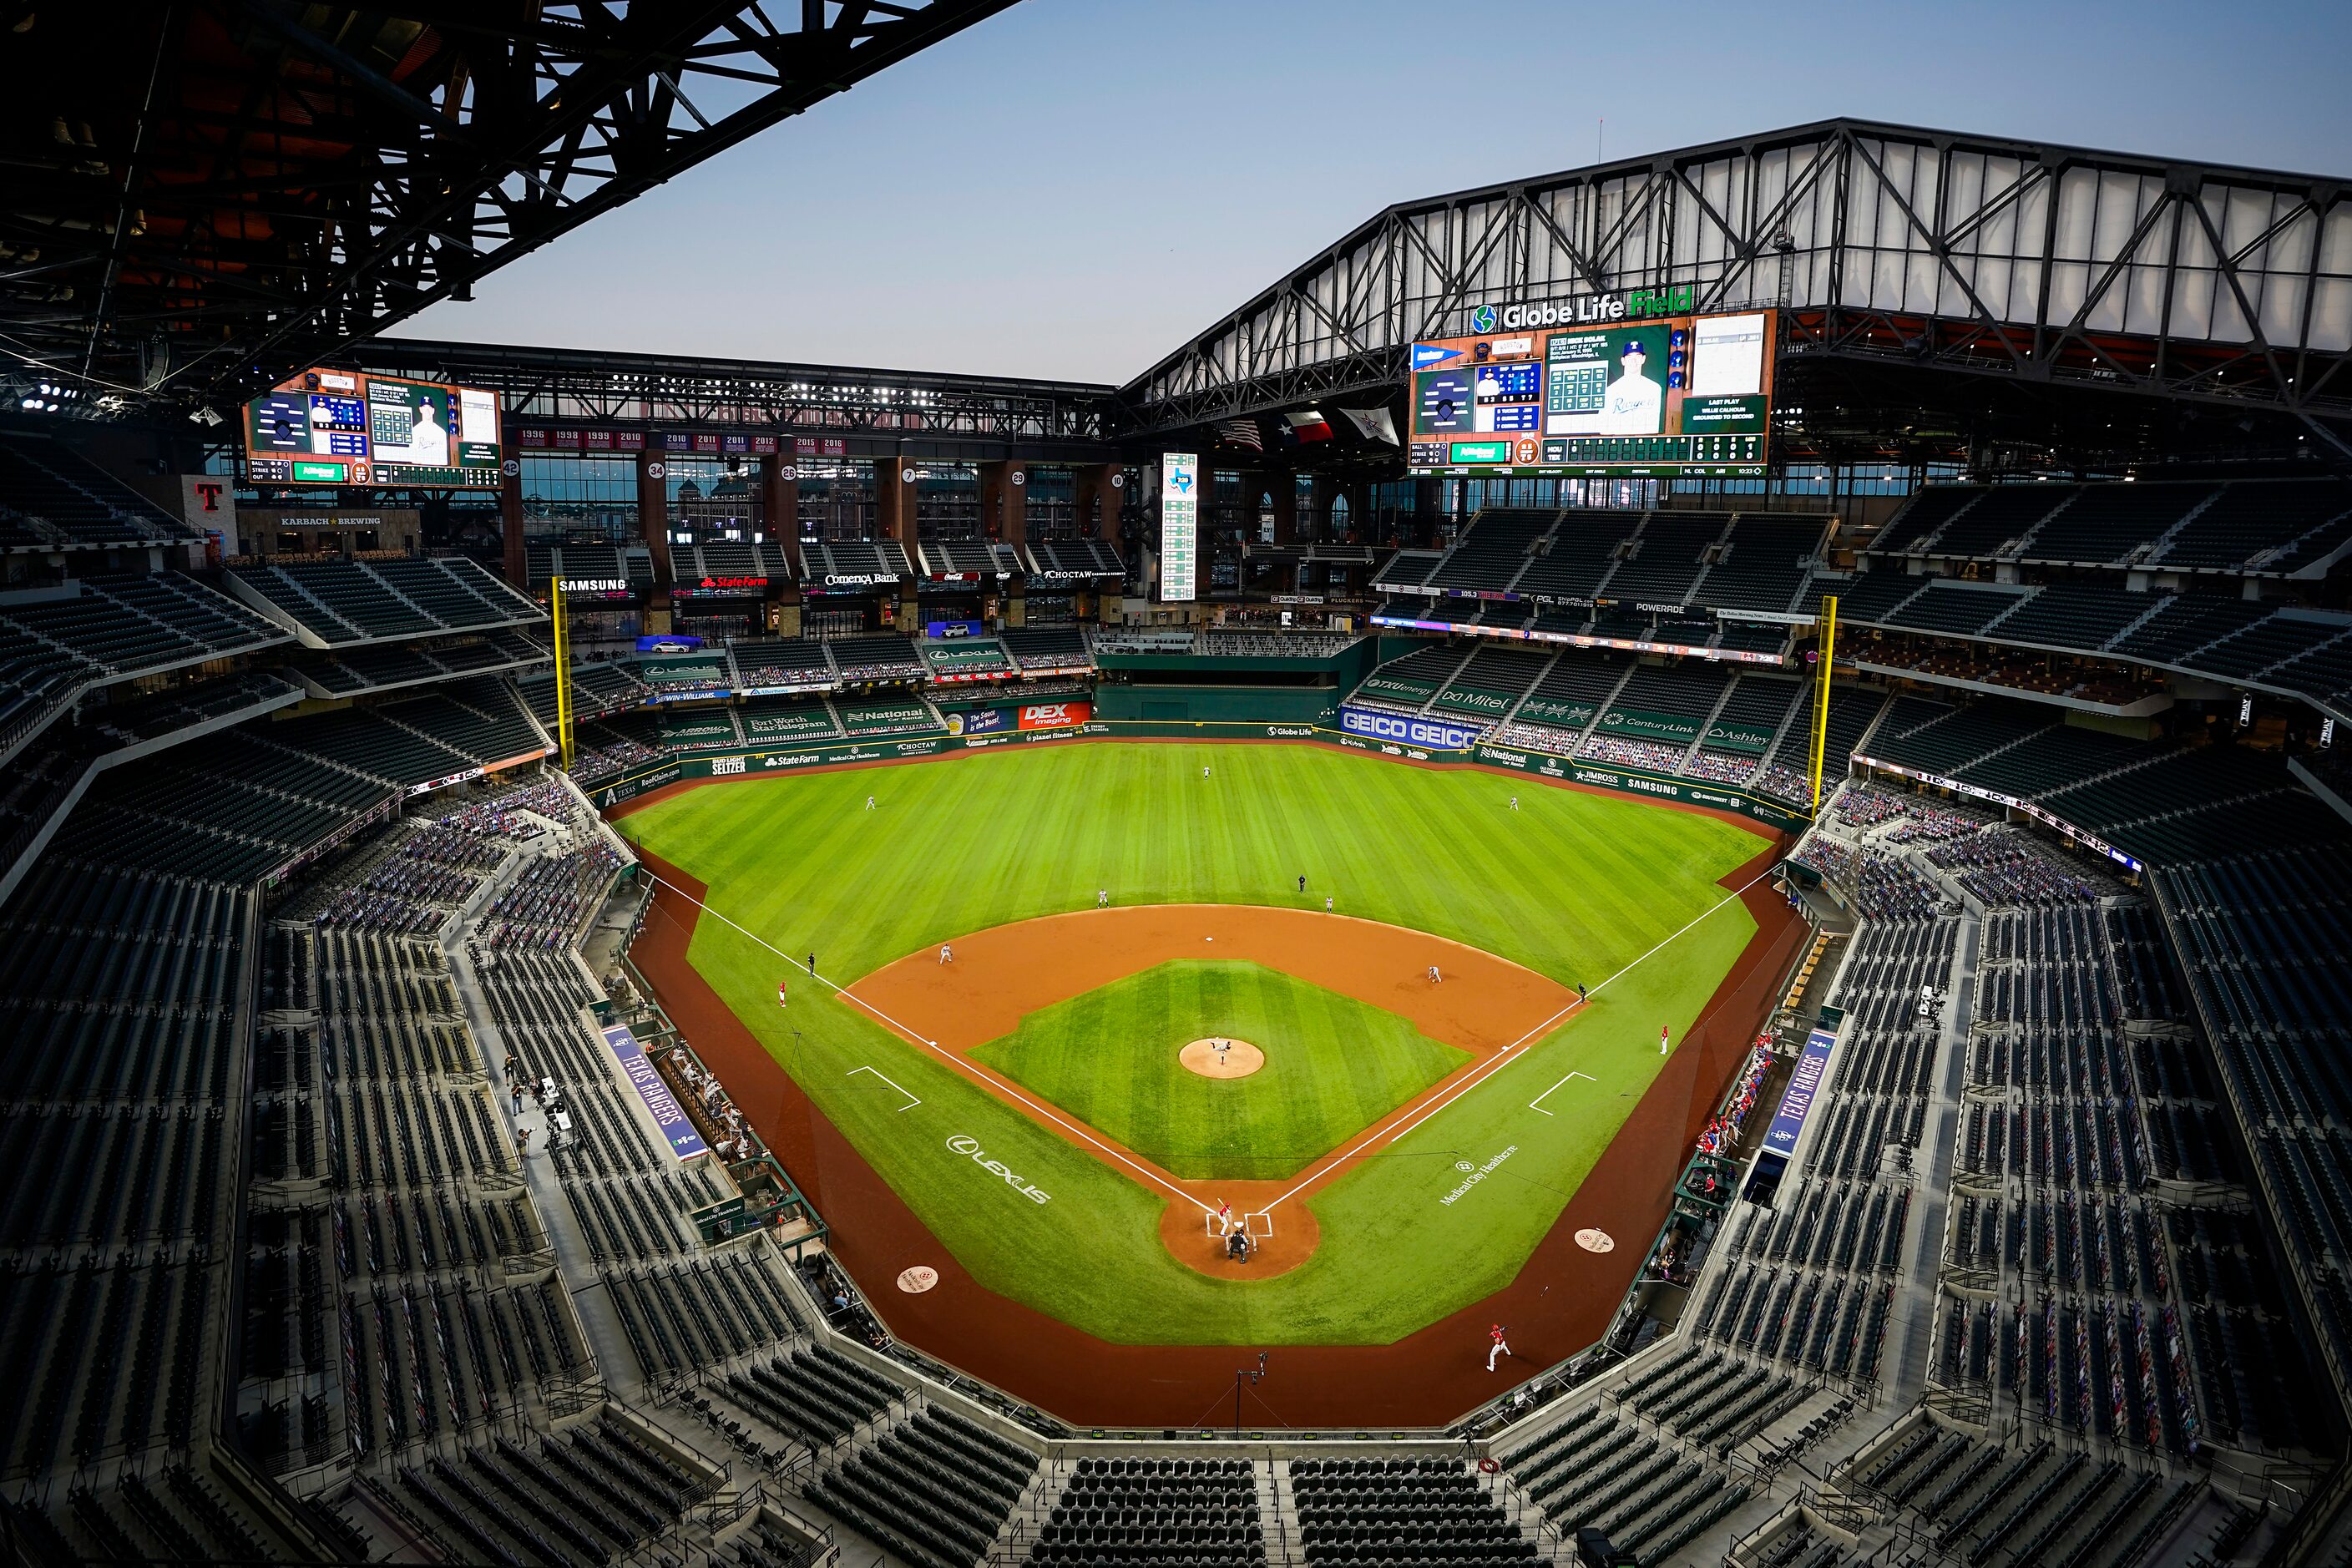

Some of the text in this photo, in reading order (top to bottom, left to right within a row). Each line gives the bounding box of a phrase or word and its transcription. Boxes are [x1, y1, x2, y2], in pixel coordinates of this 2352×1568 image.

[1503, 285, 1692, 328] Globe Life Field
[557, 431, 578, 439] 1998
[588, 432, 609, 440] 1999
[620, 432, 640, 441] 2010
[667, 434, 686, 443] 2010
[698, 435, 716, 443] 2011
[726, 436, 744, 444] 2011
[756, 437, 774, 445] 2012
[797, 438, 815, 447] 2015
[503, 463, 517, 473] 42
[650, 466, 662, 475] 34
[783, 468, 794, 477] 26
[906, 472, 912, 480] 7
[1014, 474, 1024, 483] 29
[1114, 477, 1121, 485] 10
[195, 483, 223, 511] T
[874, 573, 900, 583] Bank
[1050, 570, 1091, 579] CHOCTAW
[559, 579, 626, 591] SAMSUNG
[1636, 603, 1685, 614] POWERADE
[949, 649, 999, 657] LEXUS
[1023, 667, 1091, 677] WHATABURGER WHATABURGER
[1463, 693, 1510, 709] Mitel
[970, 715, 979, 723] The
[980, 710, 996, 720] Sauce
[1024, 704, 1068, 720] DEX
[750, 719, 772, 727] Fort
[984, 716, 1000, 726] Boss!
[1343, 711, 1407, 737] GEICO
[1626, 718, 1695, 734] CenturyLink
[677, 726, 722, 734] ARROW
[752, 721, 827, 732] Star-Telegram
[1277, 727, 1297, 736] Globe
[1722, 731, 1770, 745] Ashley
[902, 741, 937, 751] CHOCTAW
[1348, 739, 1366, 748] Kubota
[712, 762, 746, 775] SELTZER
[641, 769, 680, 787] RoofClaim.com
[618, 786, 636, 797] TEXAS
[1628, 778, 1677, 796] SAMSUNG
[623, 1054, 682, 1125] TEXAS RANGERS
[1780, 1054, 1824, 1120] TEXAS RANGERS
[972, 1151, 1051, 1204] LEXUS
[1439, 1145, 1518, 1206] Medical City Healthcare
